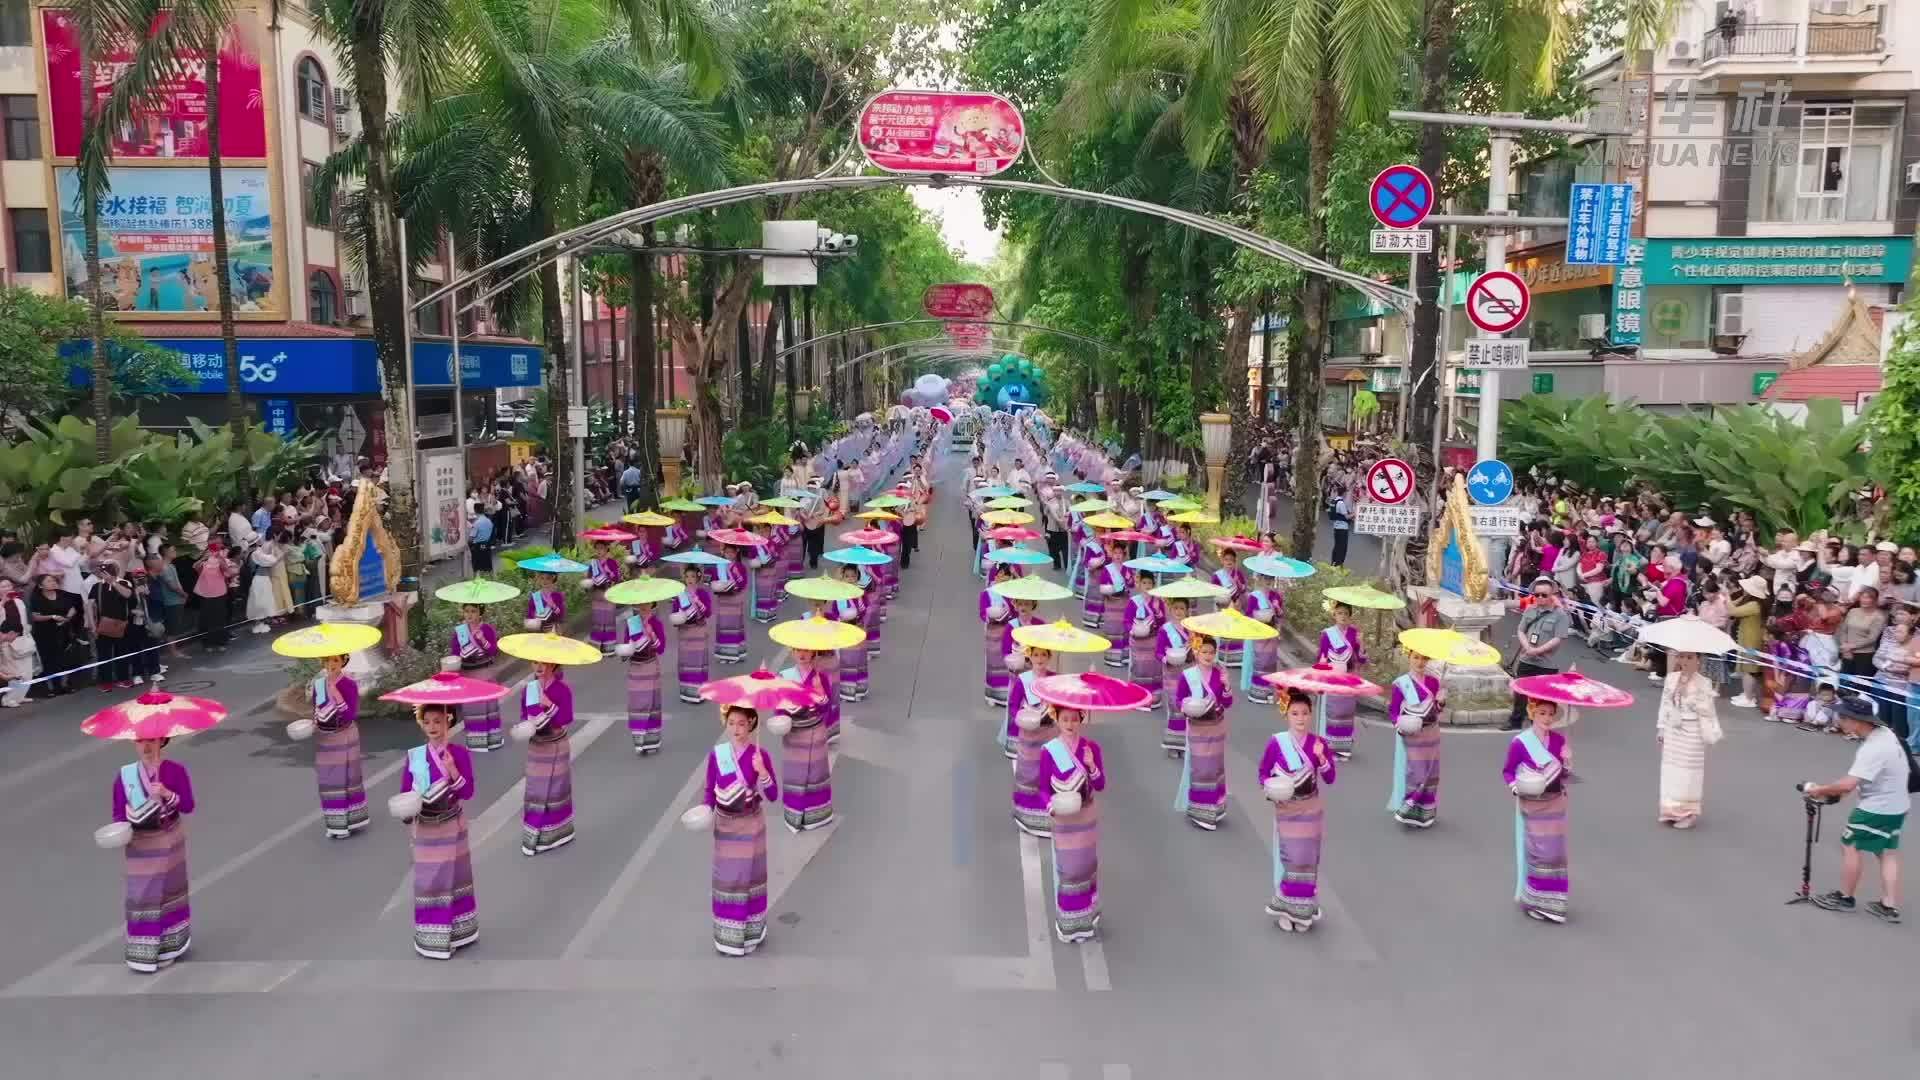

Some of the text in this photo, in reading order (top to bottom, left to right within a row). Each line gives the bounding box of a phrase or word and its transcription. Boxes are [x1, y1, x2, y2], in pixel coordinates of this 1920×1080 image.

[1468, 344, 1525, 366] 禁止鸣喇叭
